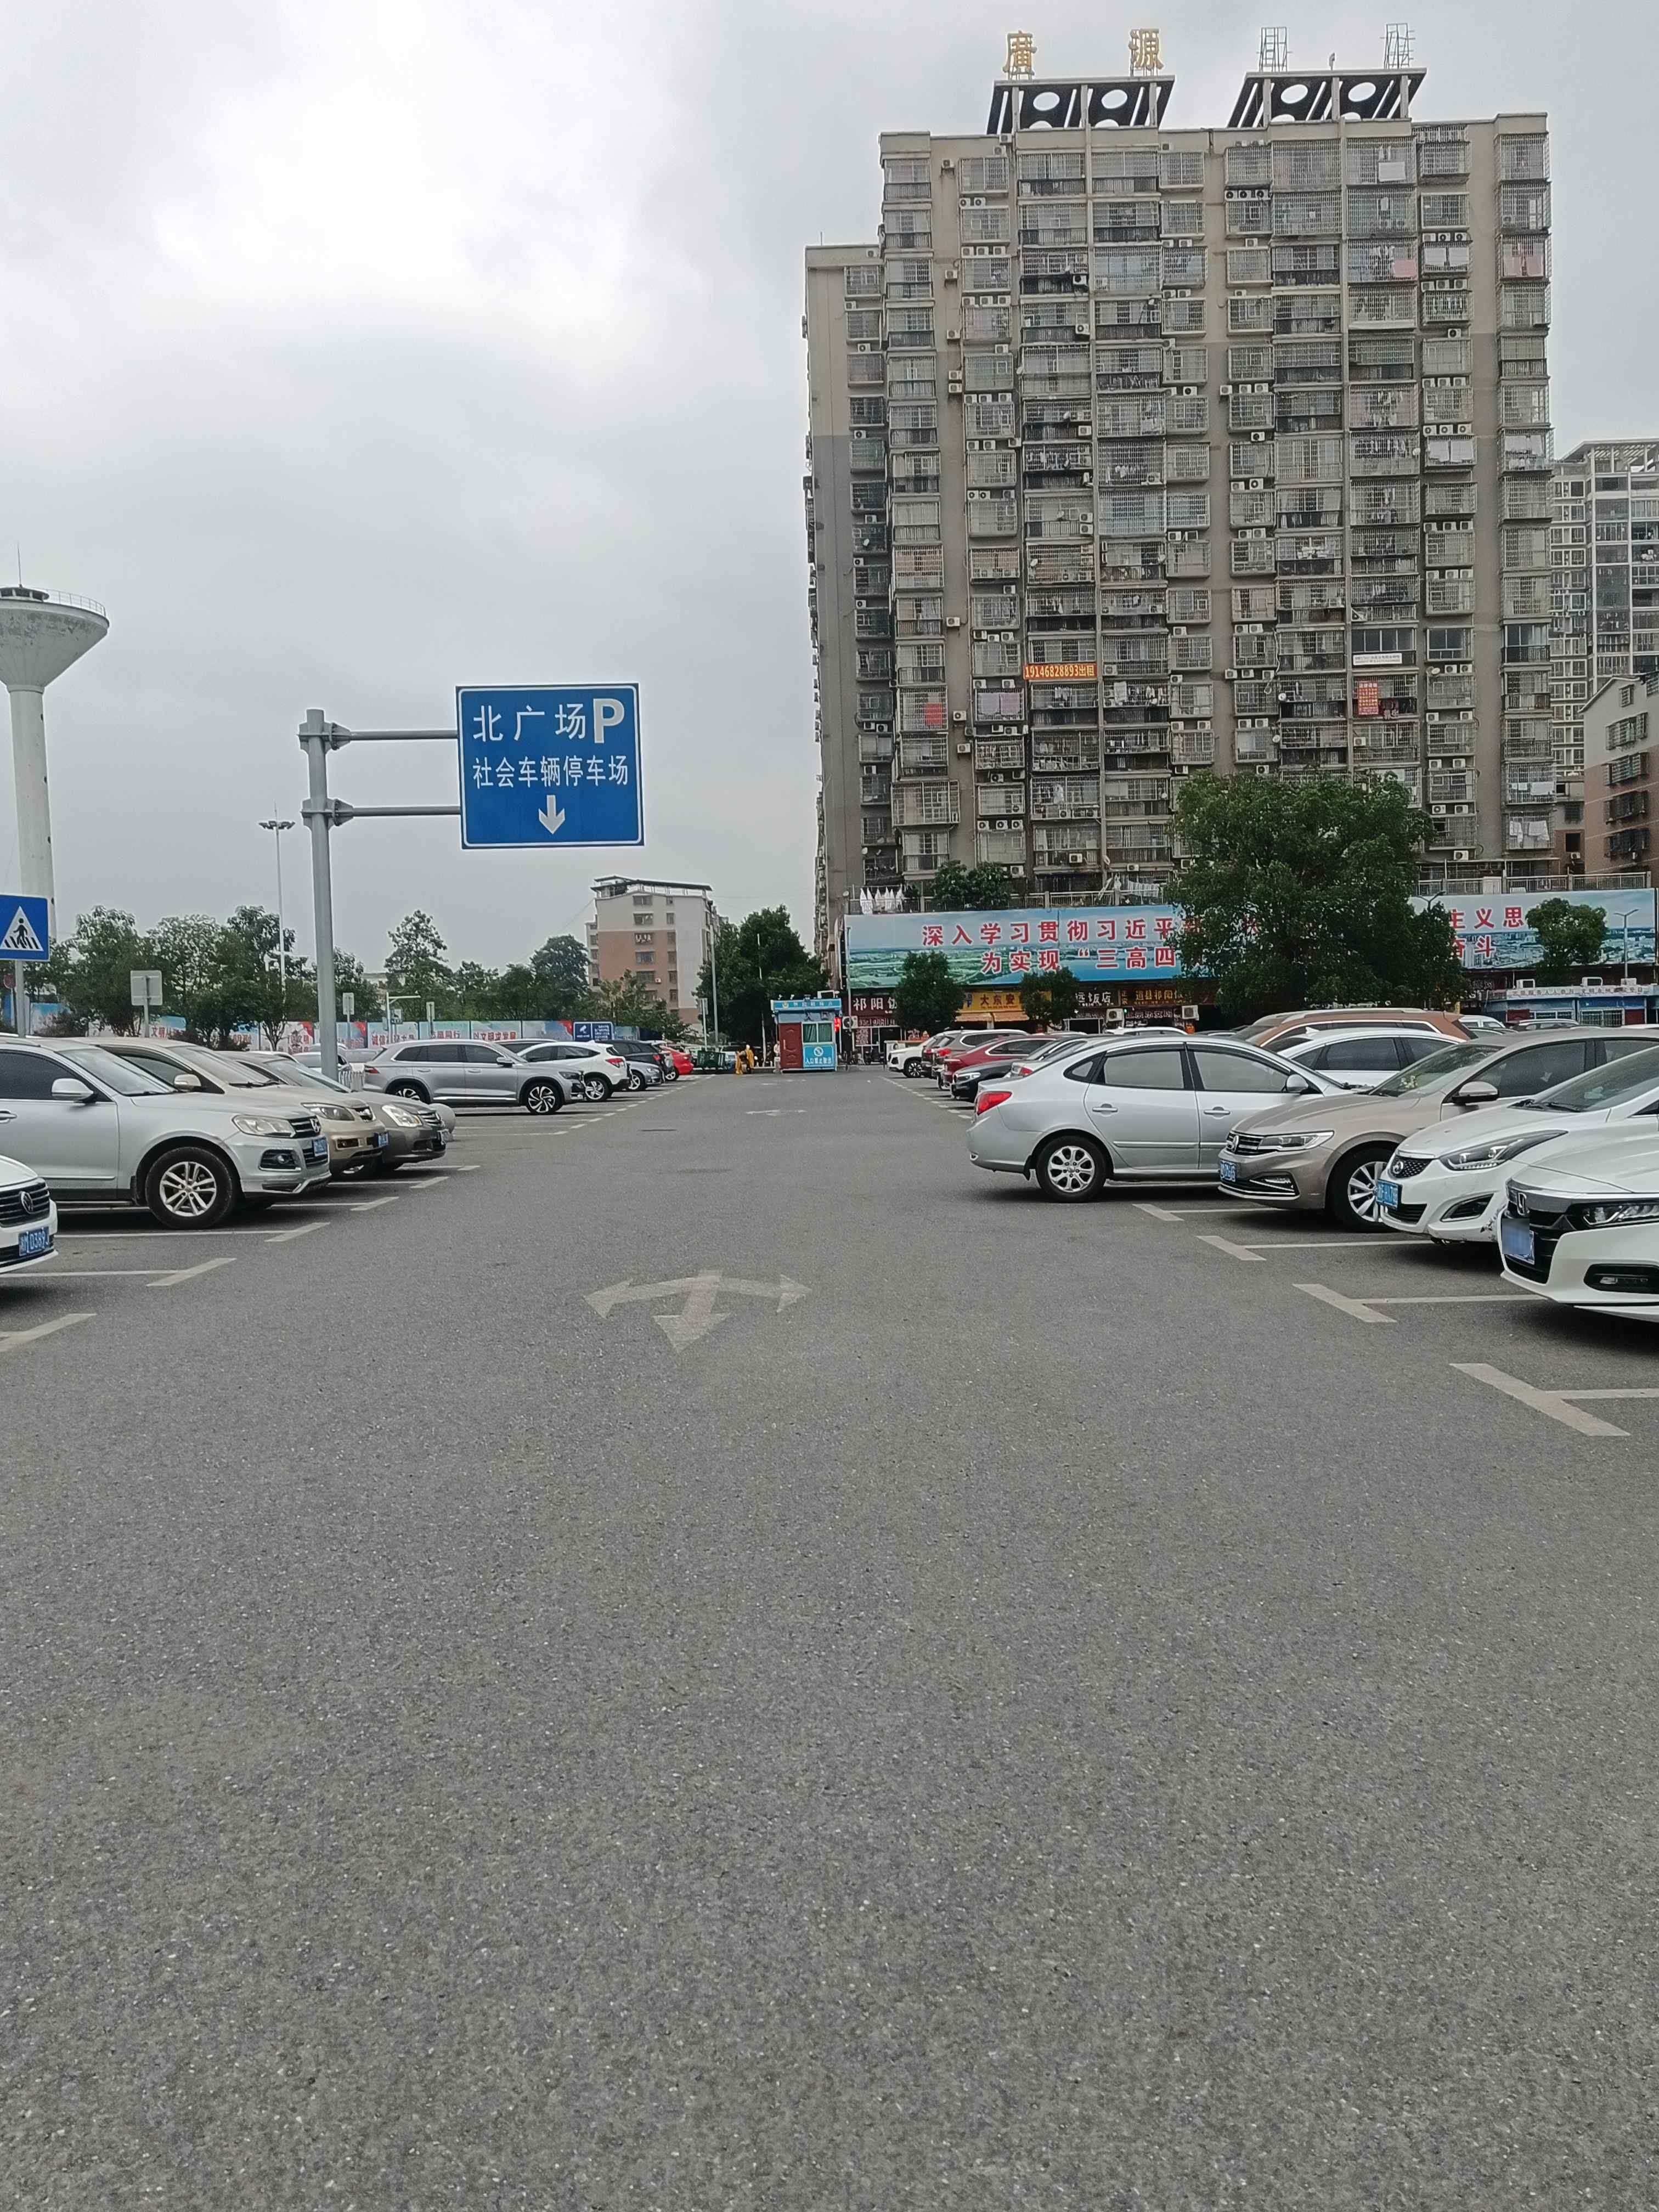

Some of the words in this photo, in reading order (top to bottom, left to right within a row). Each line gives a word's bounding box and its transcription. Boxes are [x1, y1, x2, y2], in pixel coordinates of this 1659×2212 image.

[473, 704, 586, 742] 北广场
[592, 698, 625, 743] P
[472, 755, 628, 789] 社会车辆停车场
